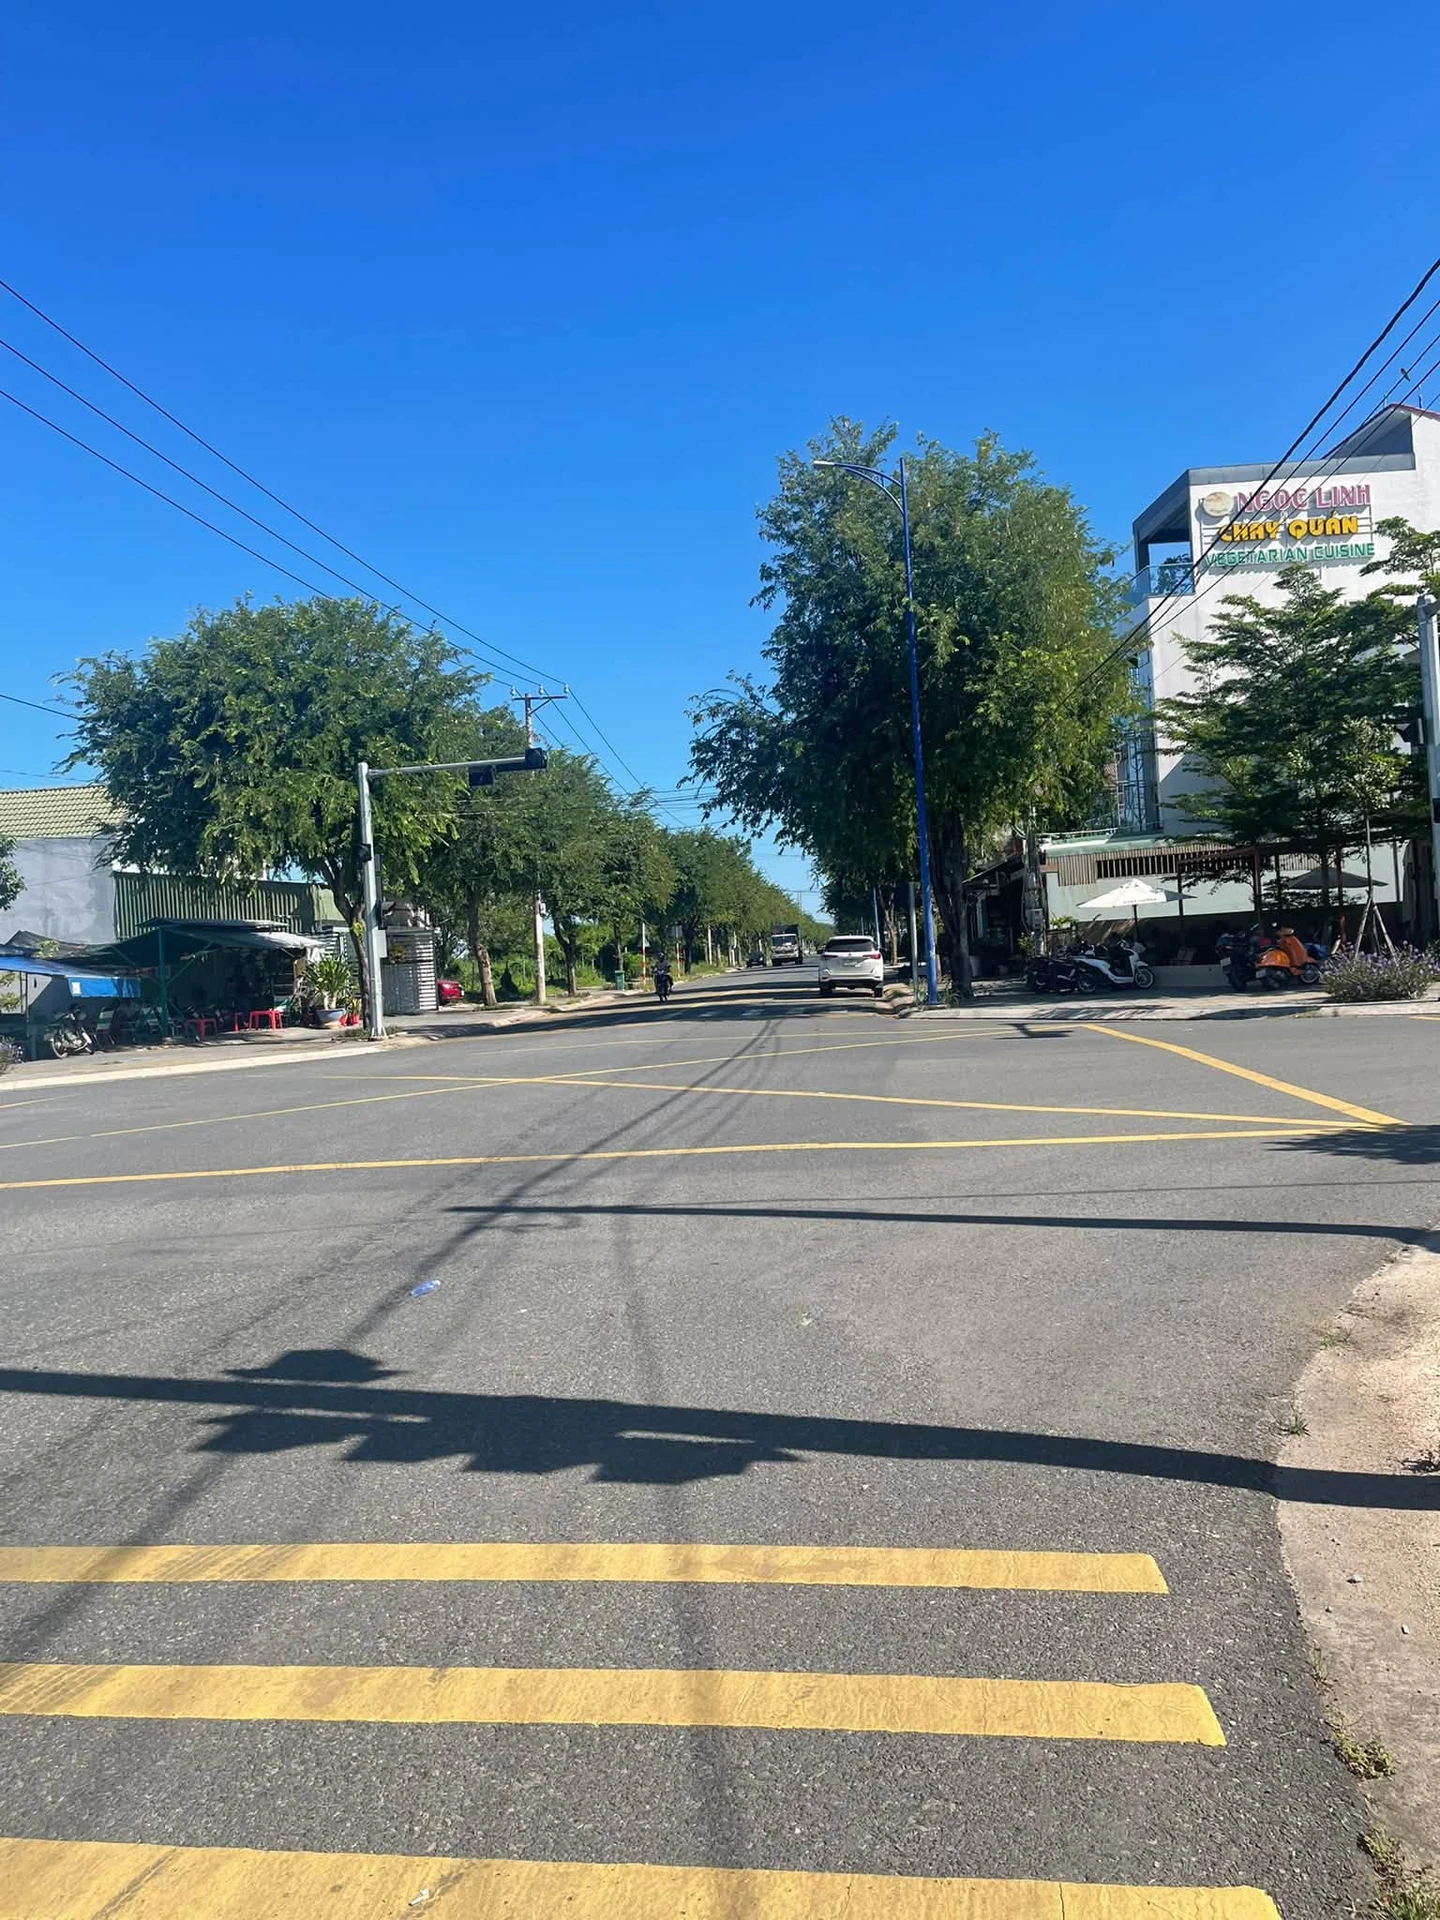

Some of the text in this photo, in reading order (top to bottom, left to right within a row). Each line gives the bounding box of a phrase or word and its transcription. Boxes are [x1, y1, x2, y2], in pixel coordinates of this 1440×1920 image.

[1317, 485, 1371, 508] LINH
[1219, 521, 1279, 543] CHAY
[1206, 543, 1375, 566] VEGETARIAN CUISINE
